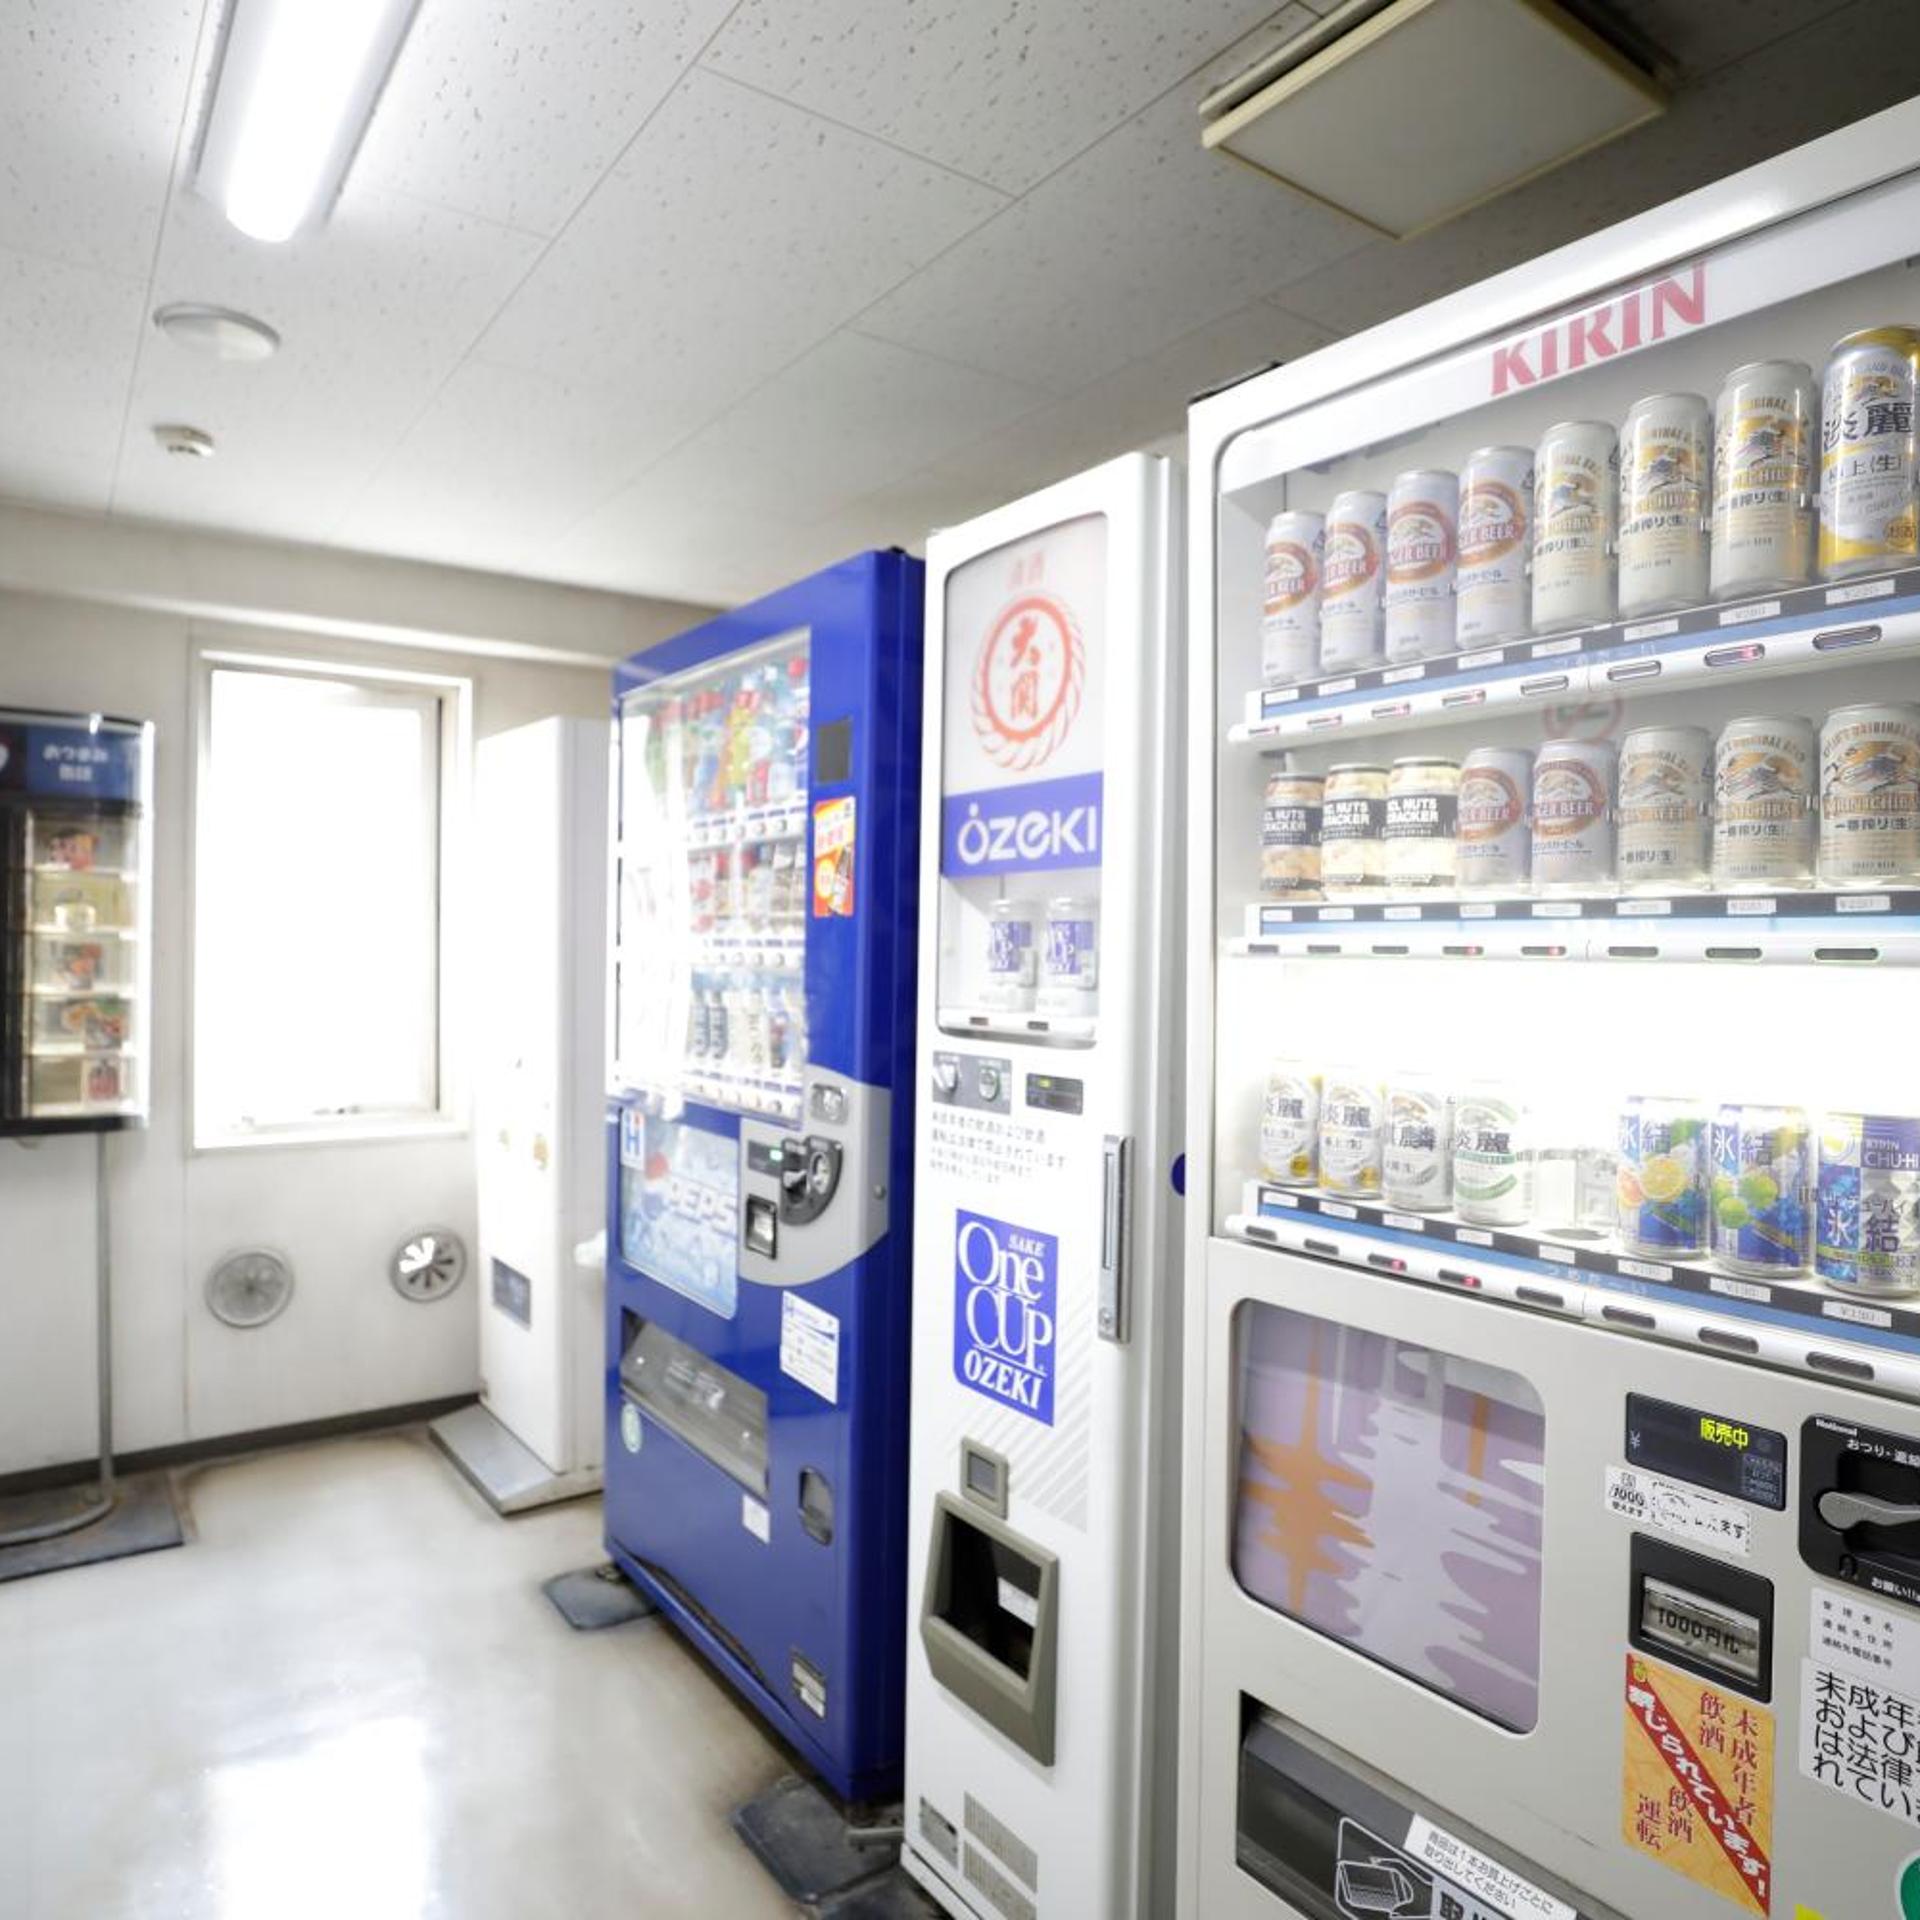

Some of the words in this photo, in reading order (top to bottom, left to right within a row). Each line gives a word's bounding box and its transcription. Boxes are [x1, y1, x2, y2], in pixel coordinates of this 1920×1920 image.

[1491, 261, 1705, 395] KIRIN
[1823, 402, 1914, 451] 淡麗
[1336, 801, 1369, 813] NUTS
[1403, 798, 1437, 810] NUTS
[1560, 800, 1595, 817] BEER
[958, 1221, 1045, 1300] One
[1008, 1233, 1046, 1258] SAKE
[966, 1284, 1053, 1371] CUP
[963, 1348, 1045, 1410] OZEKI
[1700, 1417, 1749, 1451] 販売中
[1700, 1691, 1726, 1754] 飲酒
[1815, 1670, 1920, 1729] 未成年
[1815, 1698, 1920, 1765] および
[1815, 1724, 1920, 1788] は法律
[1732, 1708, 1759, 1827] 未成年者
[1813, 1752, 1920, 1823] れてい
[1636, 1793, 1663, 1850] 運転
[1667, 1785, 1694, 1844] 飲酒
